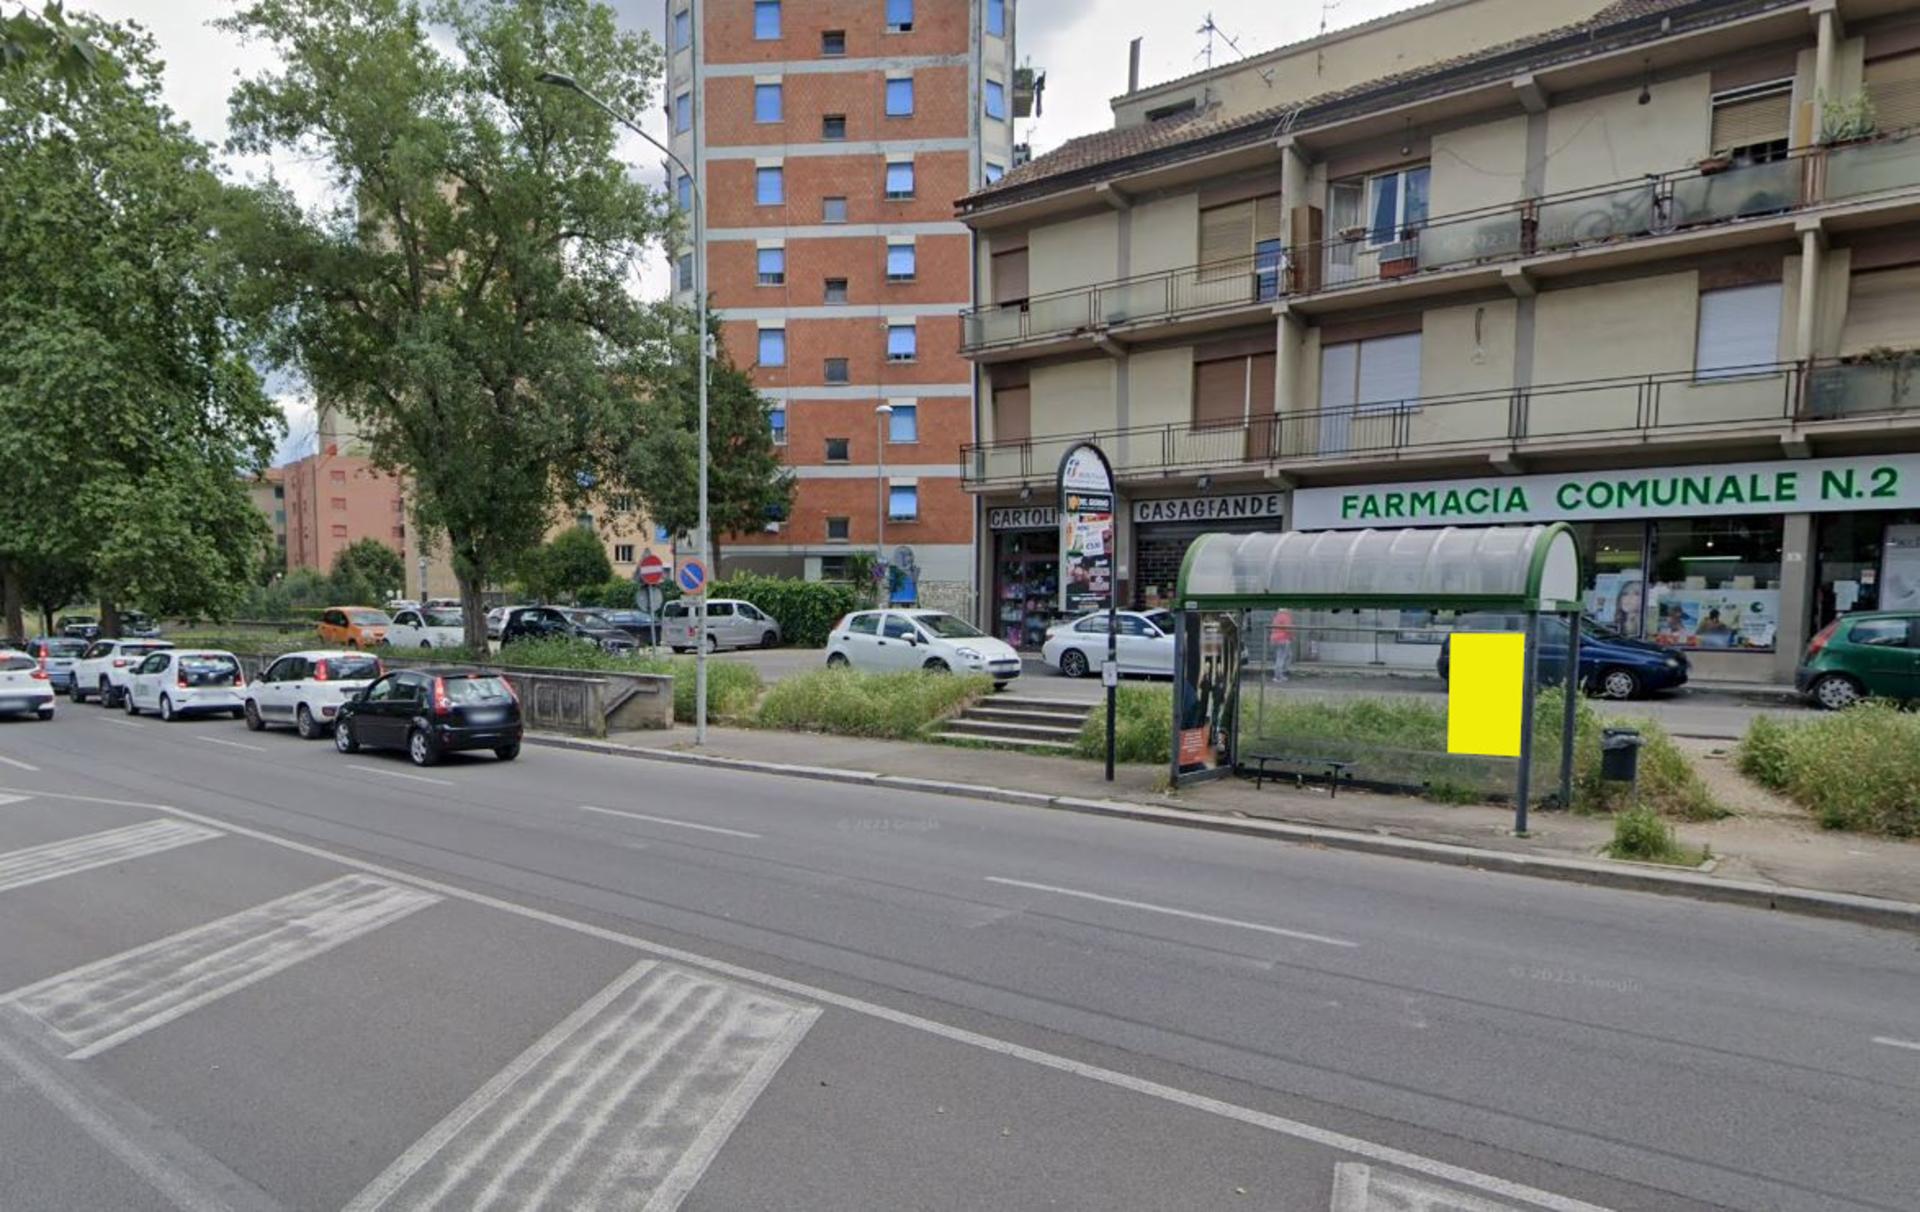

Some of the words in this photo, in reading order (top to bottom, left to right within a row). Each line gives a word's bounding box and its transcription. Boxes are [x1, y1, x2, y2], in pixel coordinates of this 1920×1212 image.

[1341, 486, 1529, 520] FARMACIA
[1556, 472, 1798, 510] COMUNALE
[1821, 467, 1898, 500] N.2
[991, 507, 1061, 527] CARTOLI
